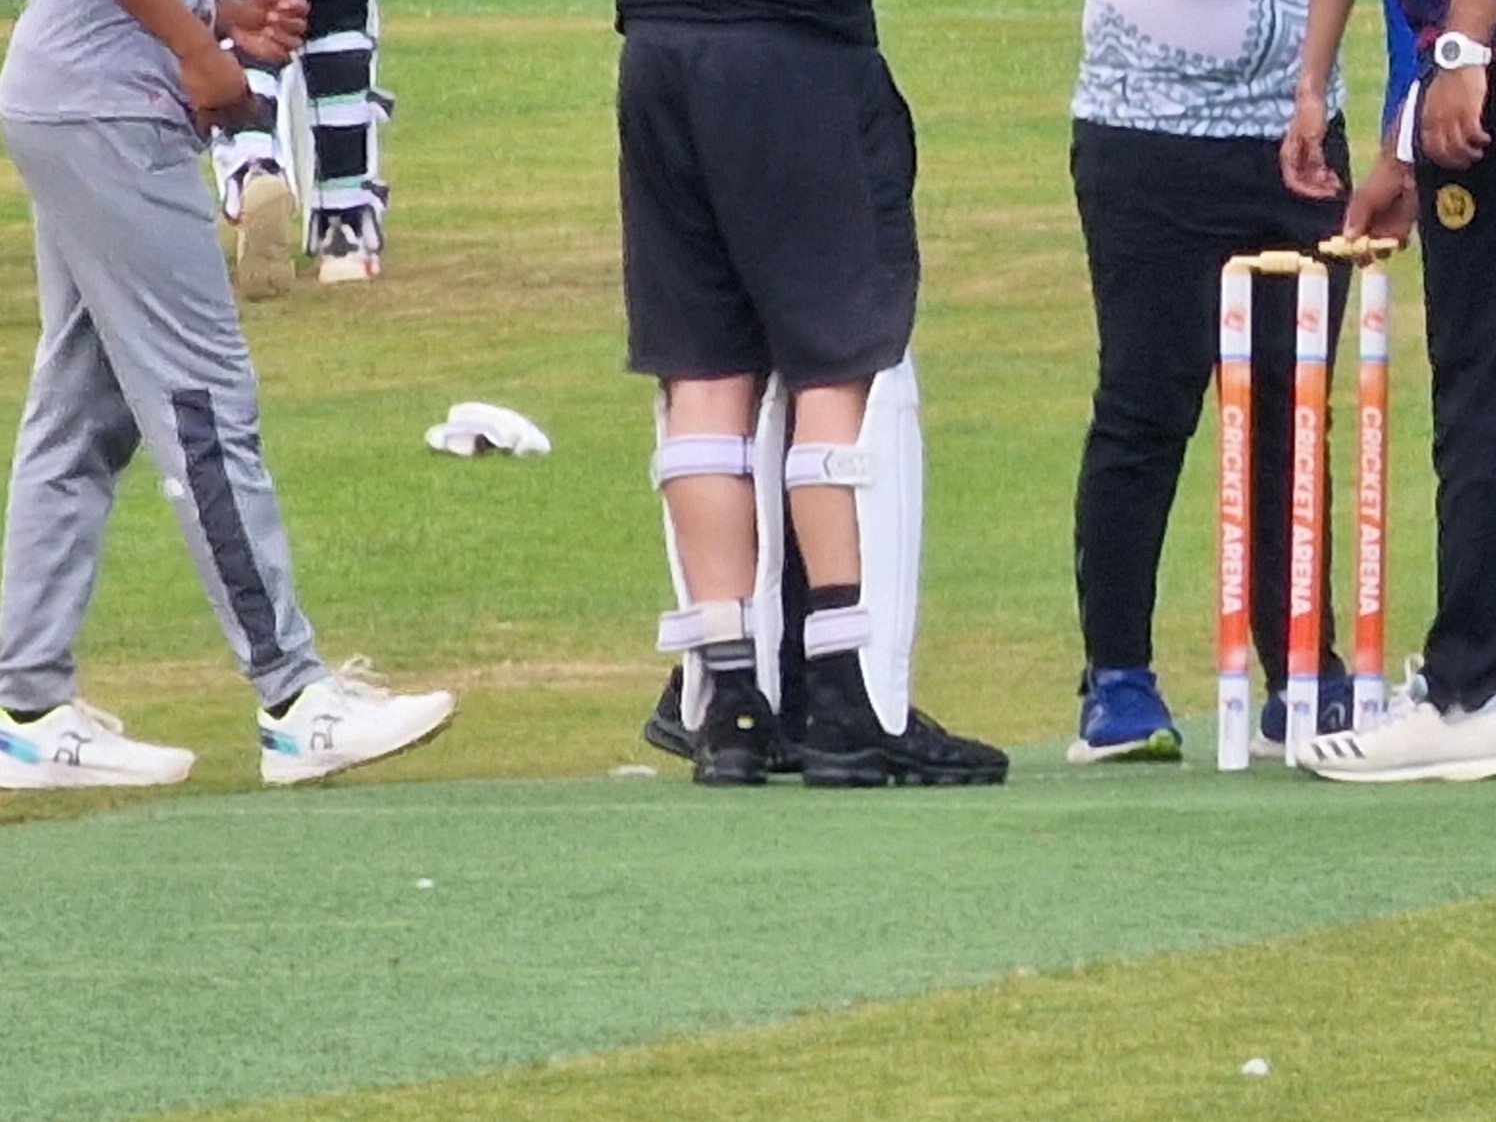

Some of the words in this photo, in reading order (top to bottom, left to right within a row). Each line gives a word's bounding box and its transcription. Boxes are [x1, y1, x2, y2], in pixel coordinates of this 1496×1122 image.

[1222, 404, 1244, 521] CRICKET
[1293, 404, 1316, 522] CRICKET
[1360, 404, 1383, 521] CRICKET
[1222, 521, 1244, 616] ARENA
[1291, 526, 1314, 618] ARENA
[1358, 523, 1381, 617] ARENA
